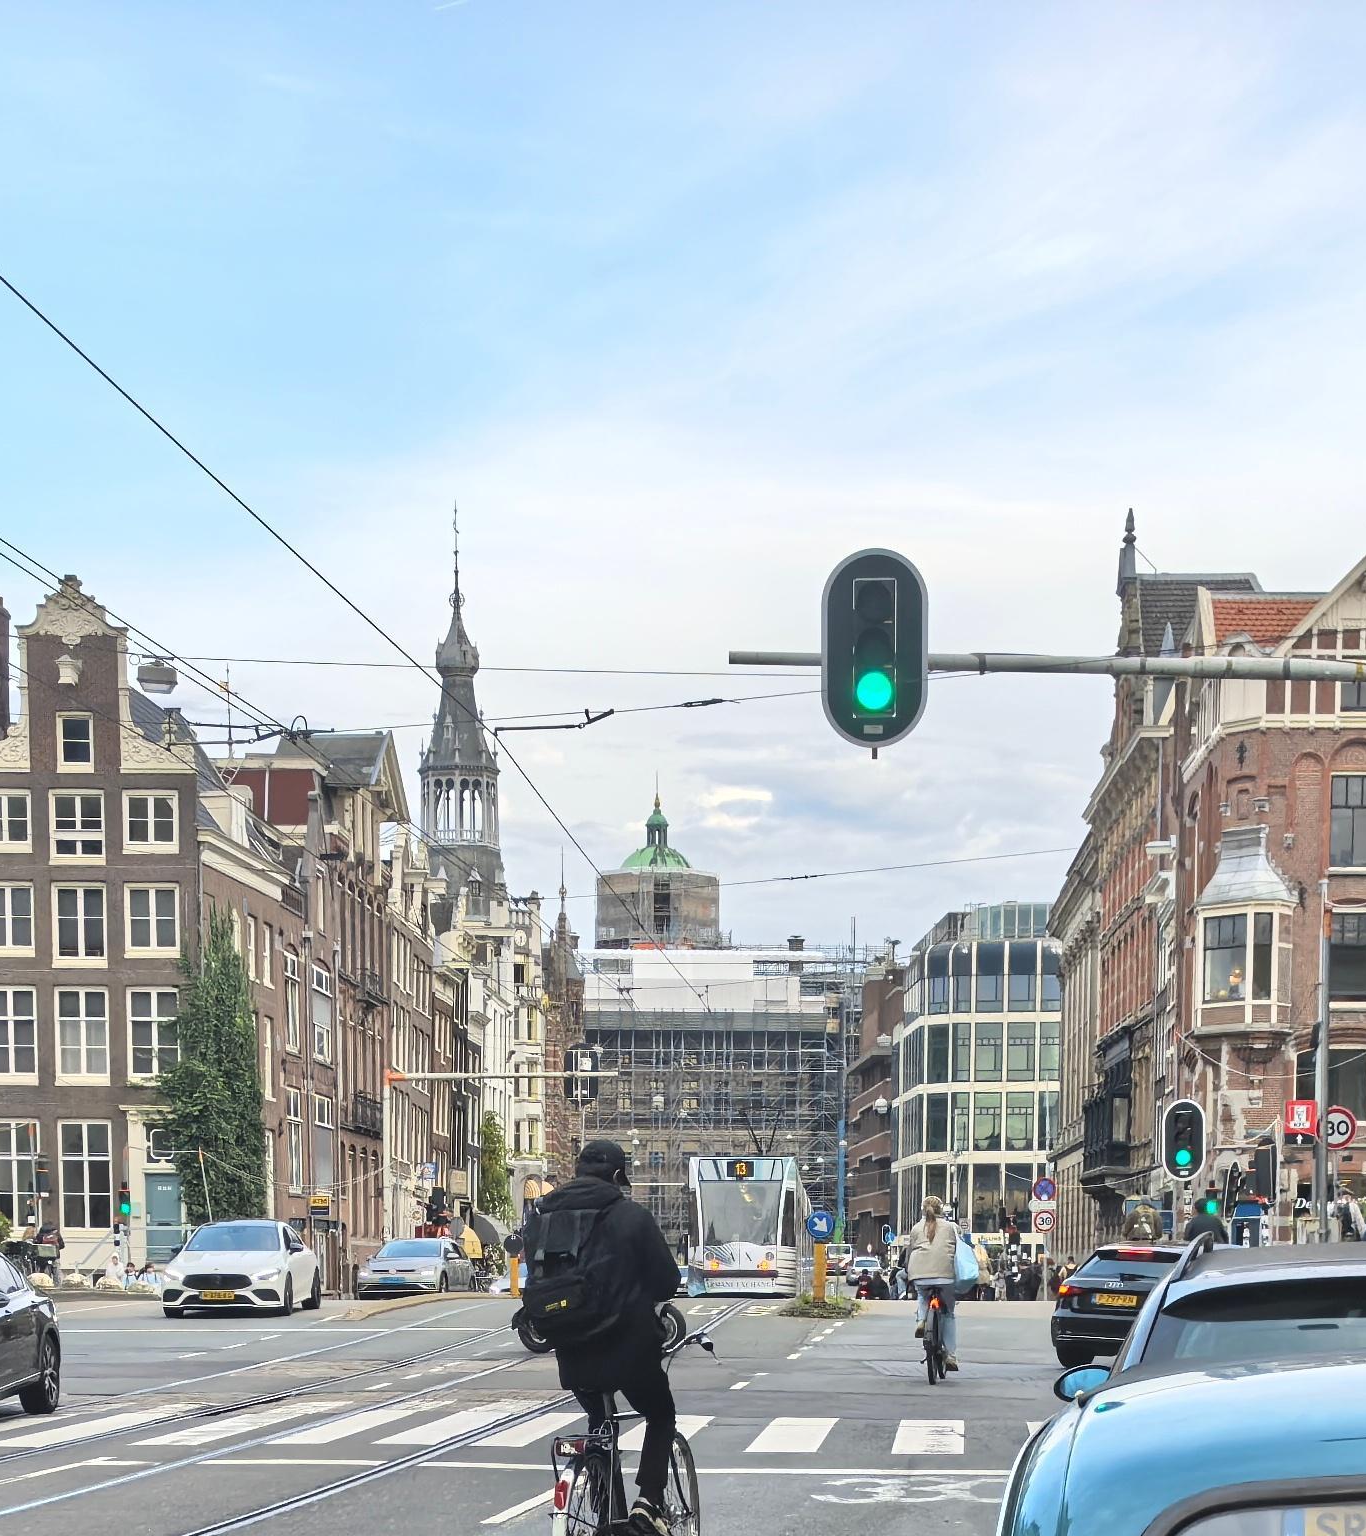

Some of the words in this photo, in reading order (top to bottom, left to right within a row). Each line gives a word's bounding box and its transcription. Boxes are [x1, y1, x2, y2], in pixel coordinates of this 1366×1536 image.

[1327, 1120, 1350, 1137] 30
[735, 1162, 748, 1176] 13
[1037, 1216, 1052, 1226] 30
